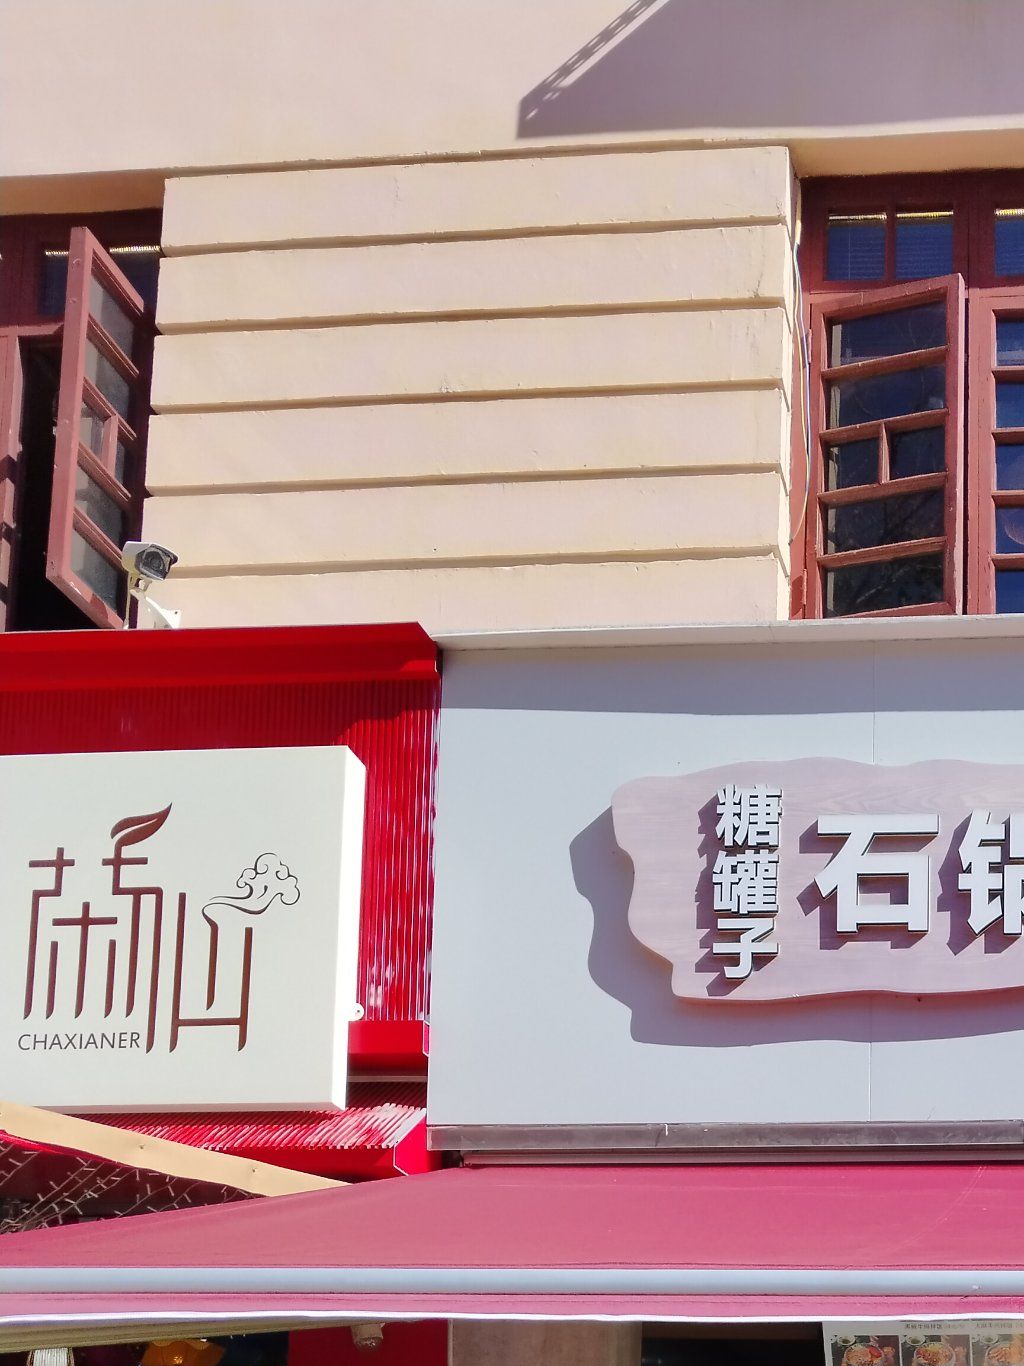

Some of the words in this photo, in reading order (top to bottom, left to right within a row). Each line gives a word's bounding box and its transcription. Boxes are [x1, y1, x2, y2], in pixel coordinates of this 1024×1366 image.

[711, 783, 783, 981] 糖罐子
[18, 1031, 142, 1052] CHAXIANER
